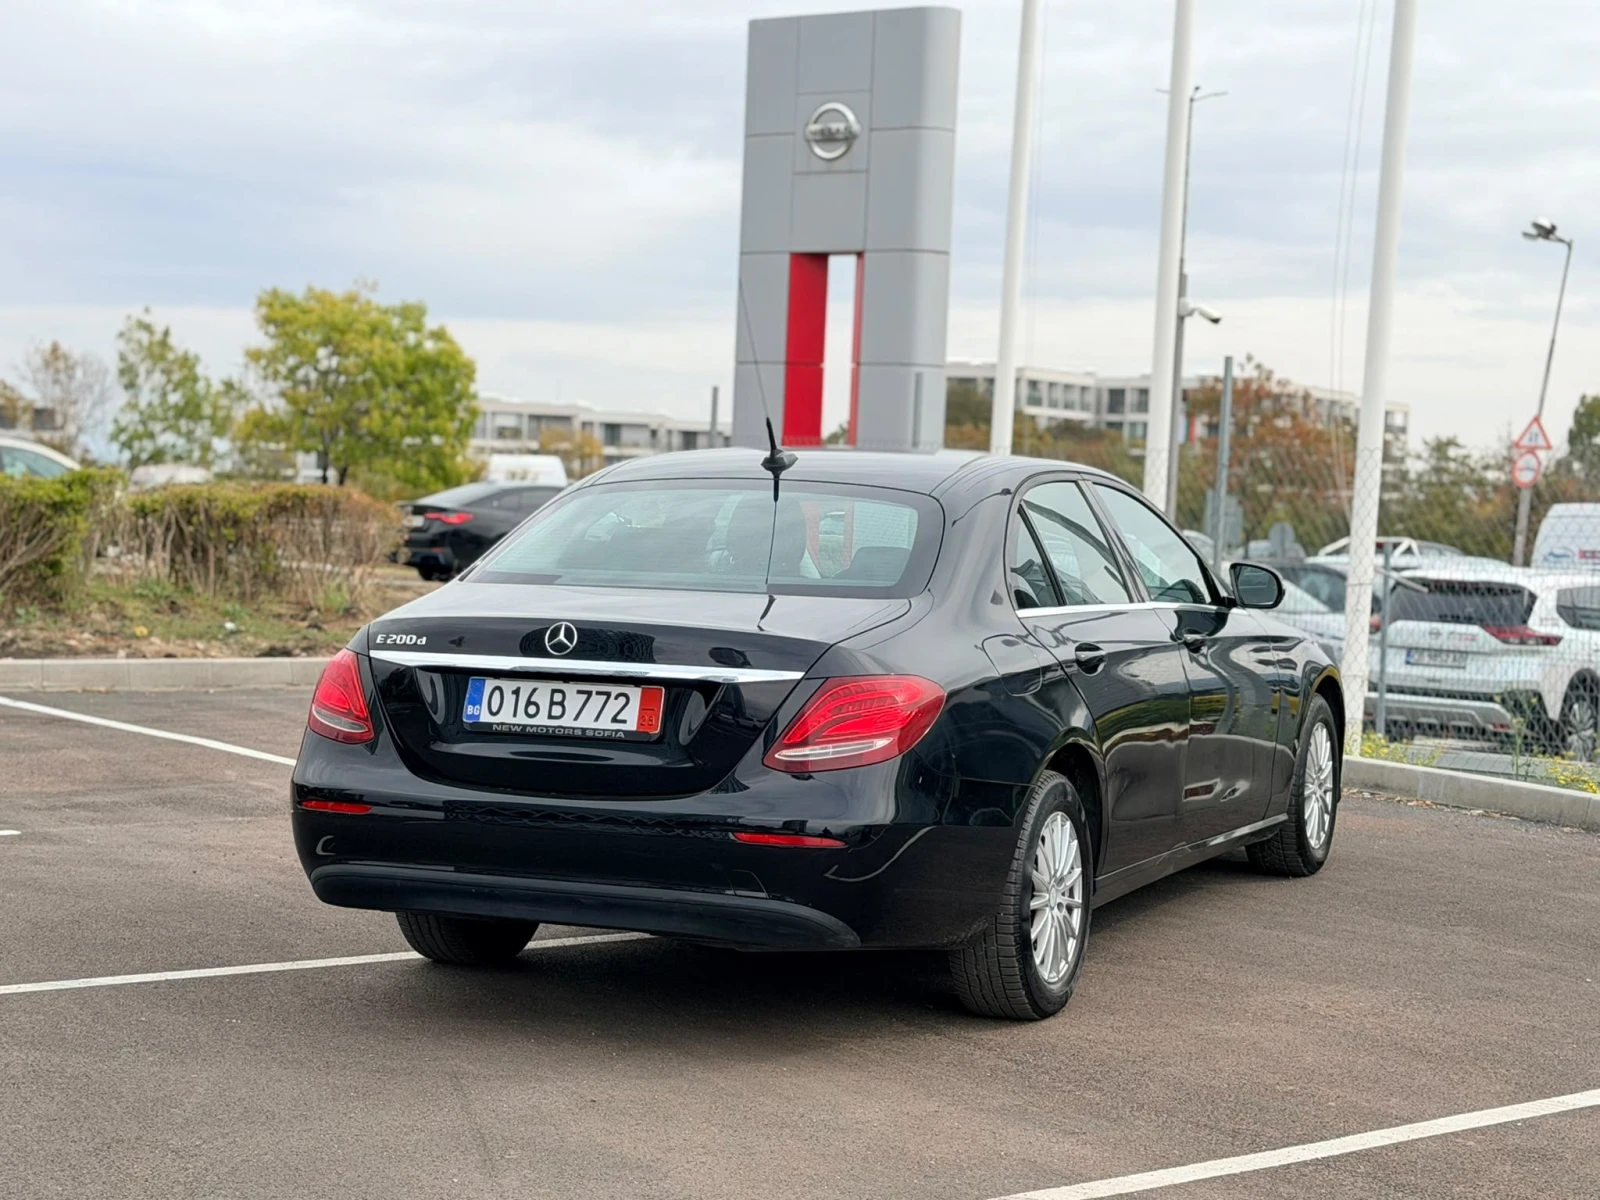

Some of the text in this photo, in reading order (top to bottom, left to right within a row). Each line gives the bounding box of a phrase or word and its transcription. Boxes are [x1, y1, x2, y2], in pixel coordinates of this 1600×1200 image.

[466, 704, 480, 716] BG
[492, 724, 625, 738] NEW MOTORS SOFIA
